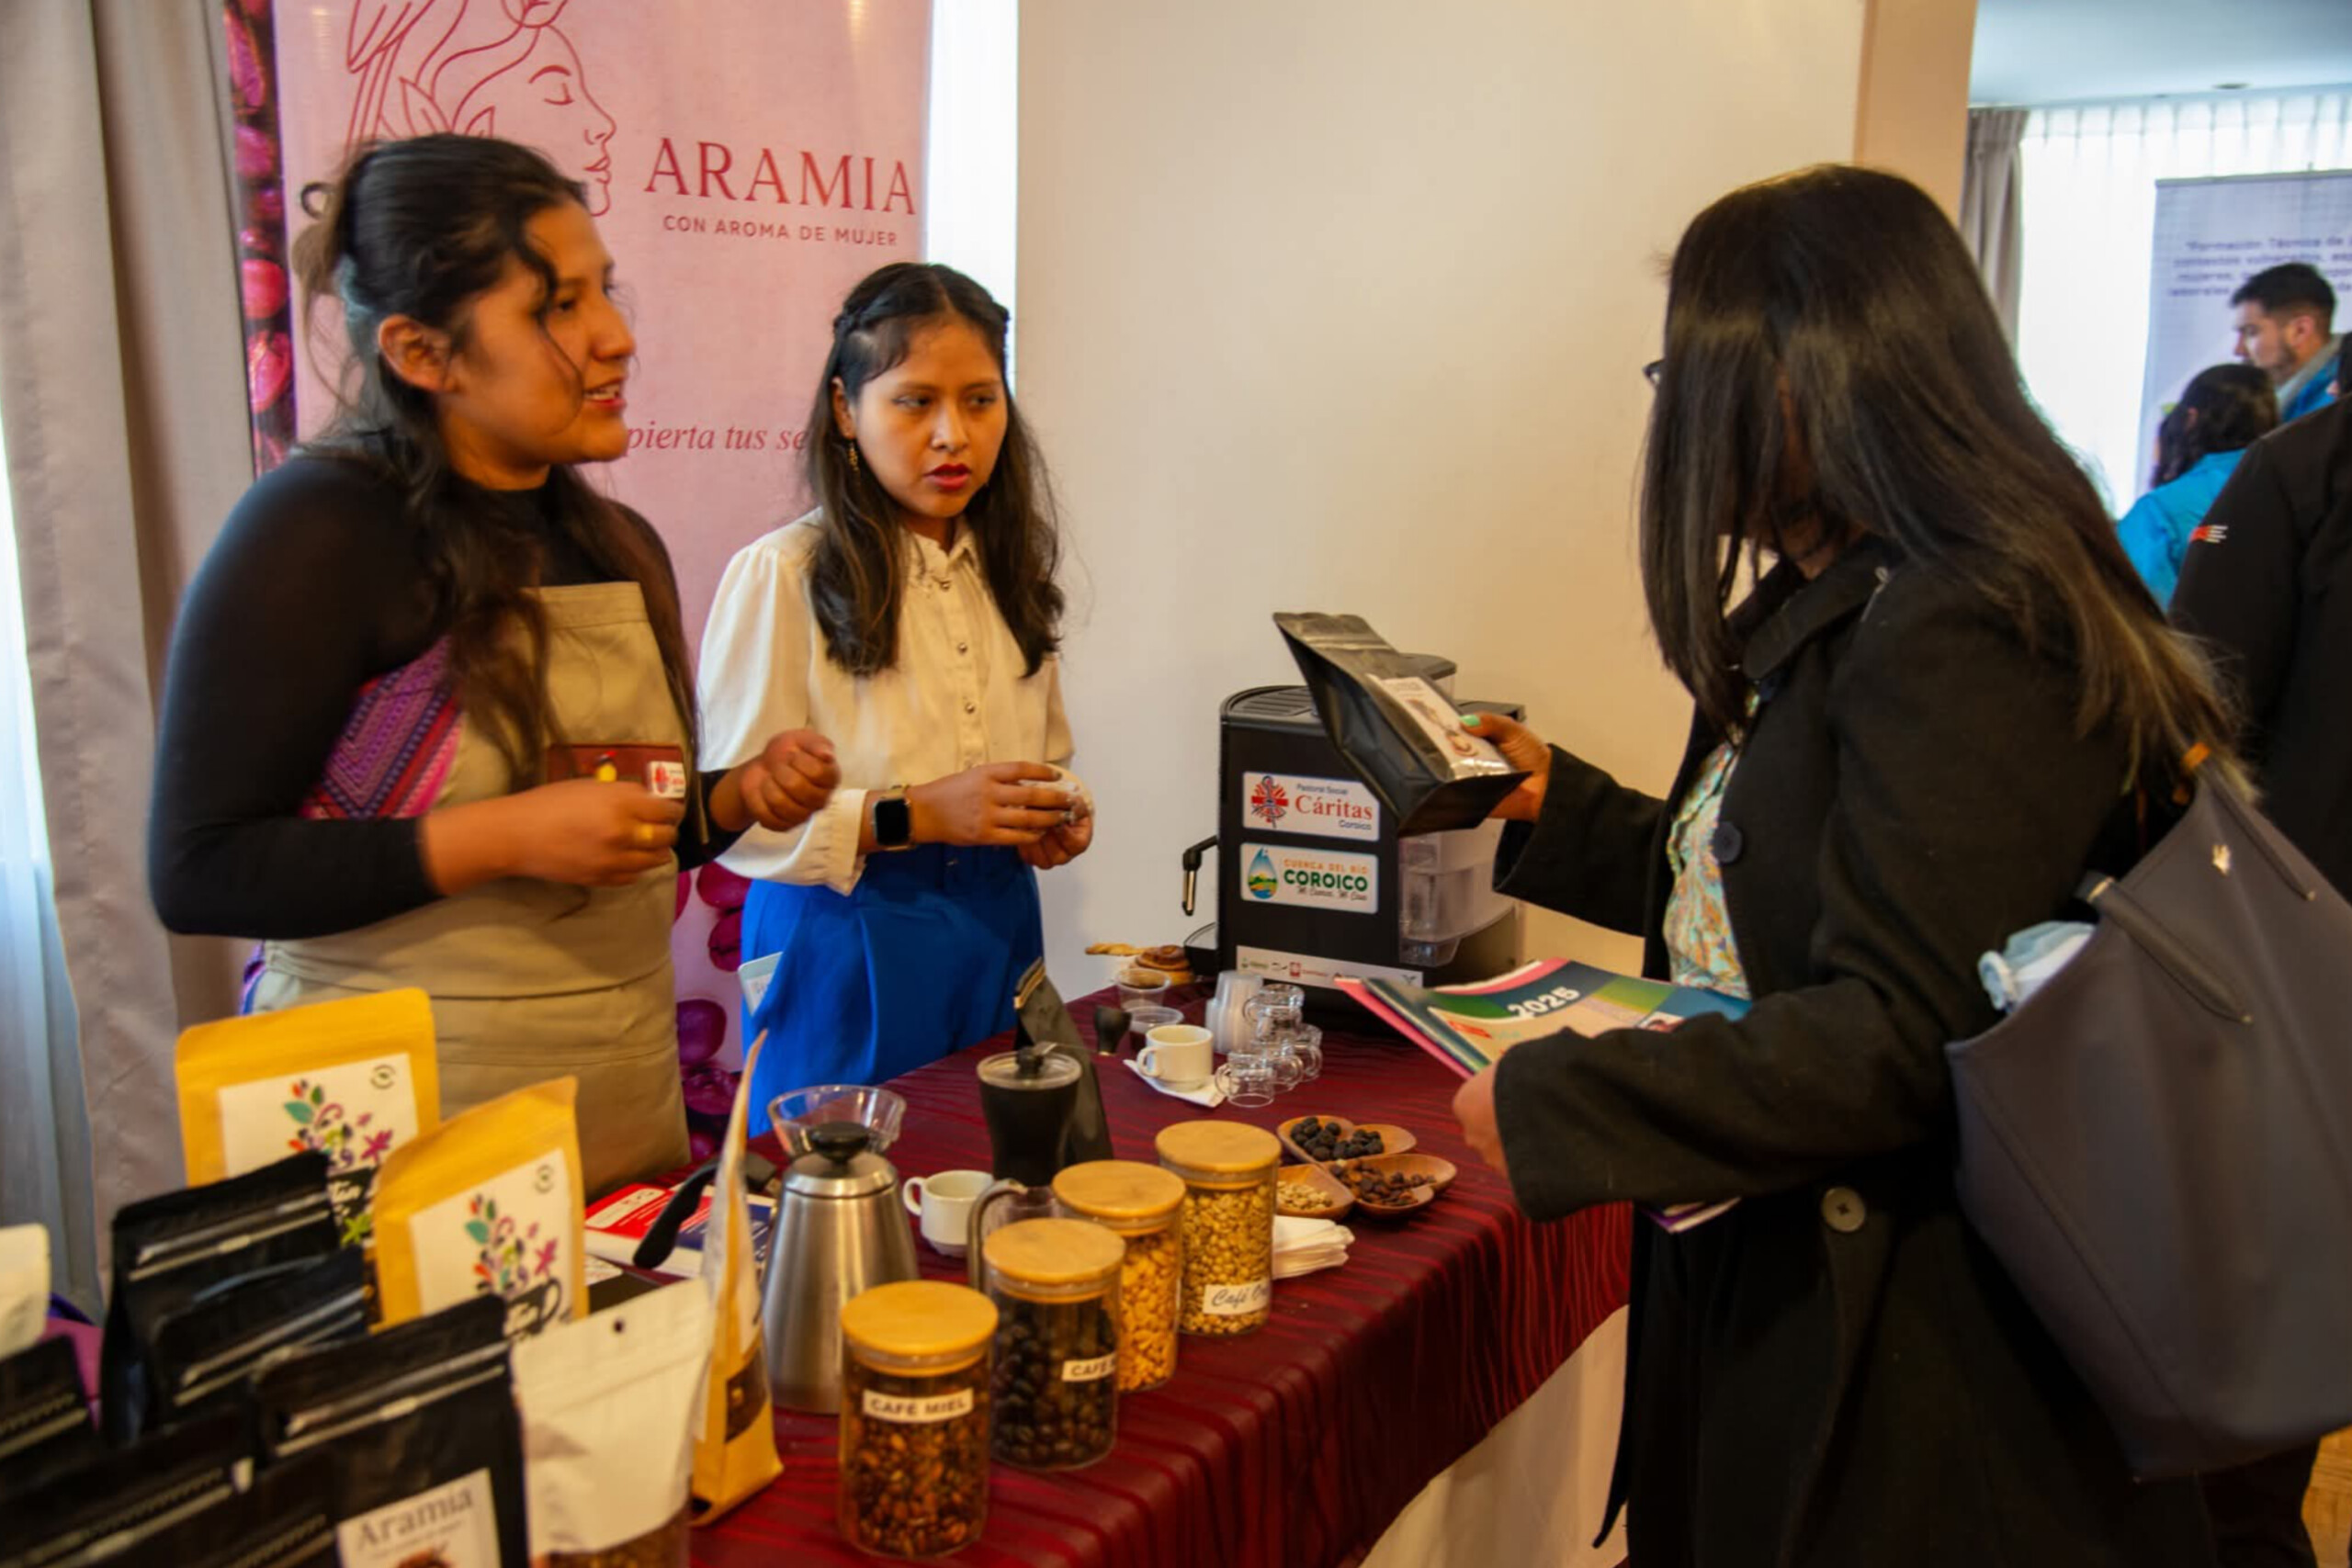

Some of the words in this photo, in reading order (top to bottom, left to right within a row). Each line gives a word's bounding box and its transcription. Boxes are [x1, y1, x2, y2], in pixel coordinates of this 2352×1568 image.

[644, 137, 916, 215] ARAMIA
[663, 214, 707, 233] CON
[715, 220, 790, 240] AROMA
[799, 225, 825, 242] DE
[834, 229, 898, 247] MUJER
[724, 424, 768, 450] tus
[1295, 794, 1374, 820] Cáritas
[1283, 859, 1324, 871] CUENCA
[1329, 863, 1345, 873] DEL
[1283, 869, 1369, 893] COROICO
[1507, 986, 1581, 1020] 2025
[925, 1396, 966, 1414] MIEL
[357, 1488, 474, 1551] Aramia
